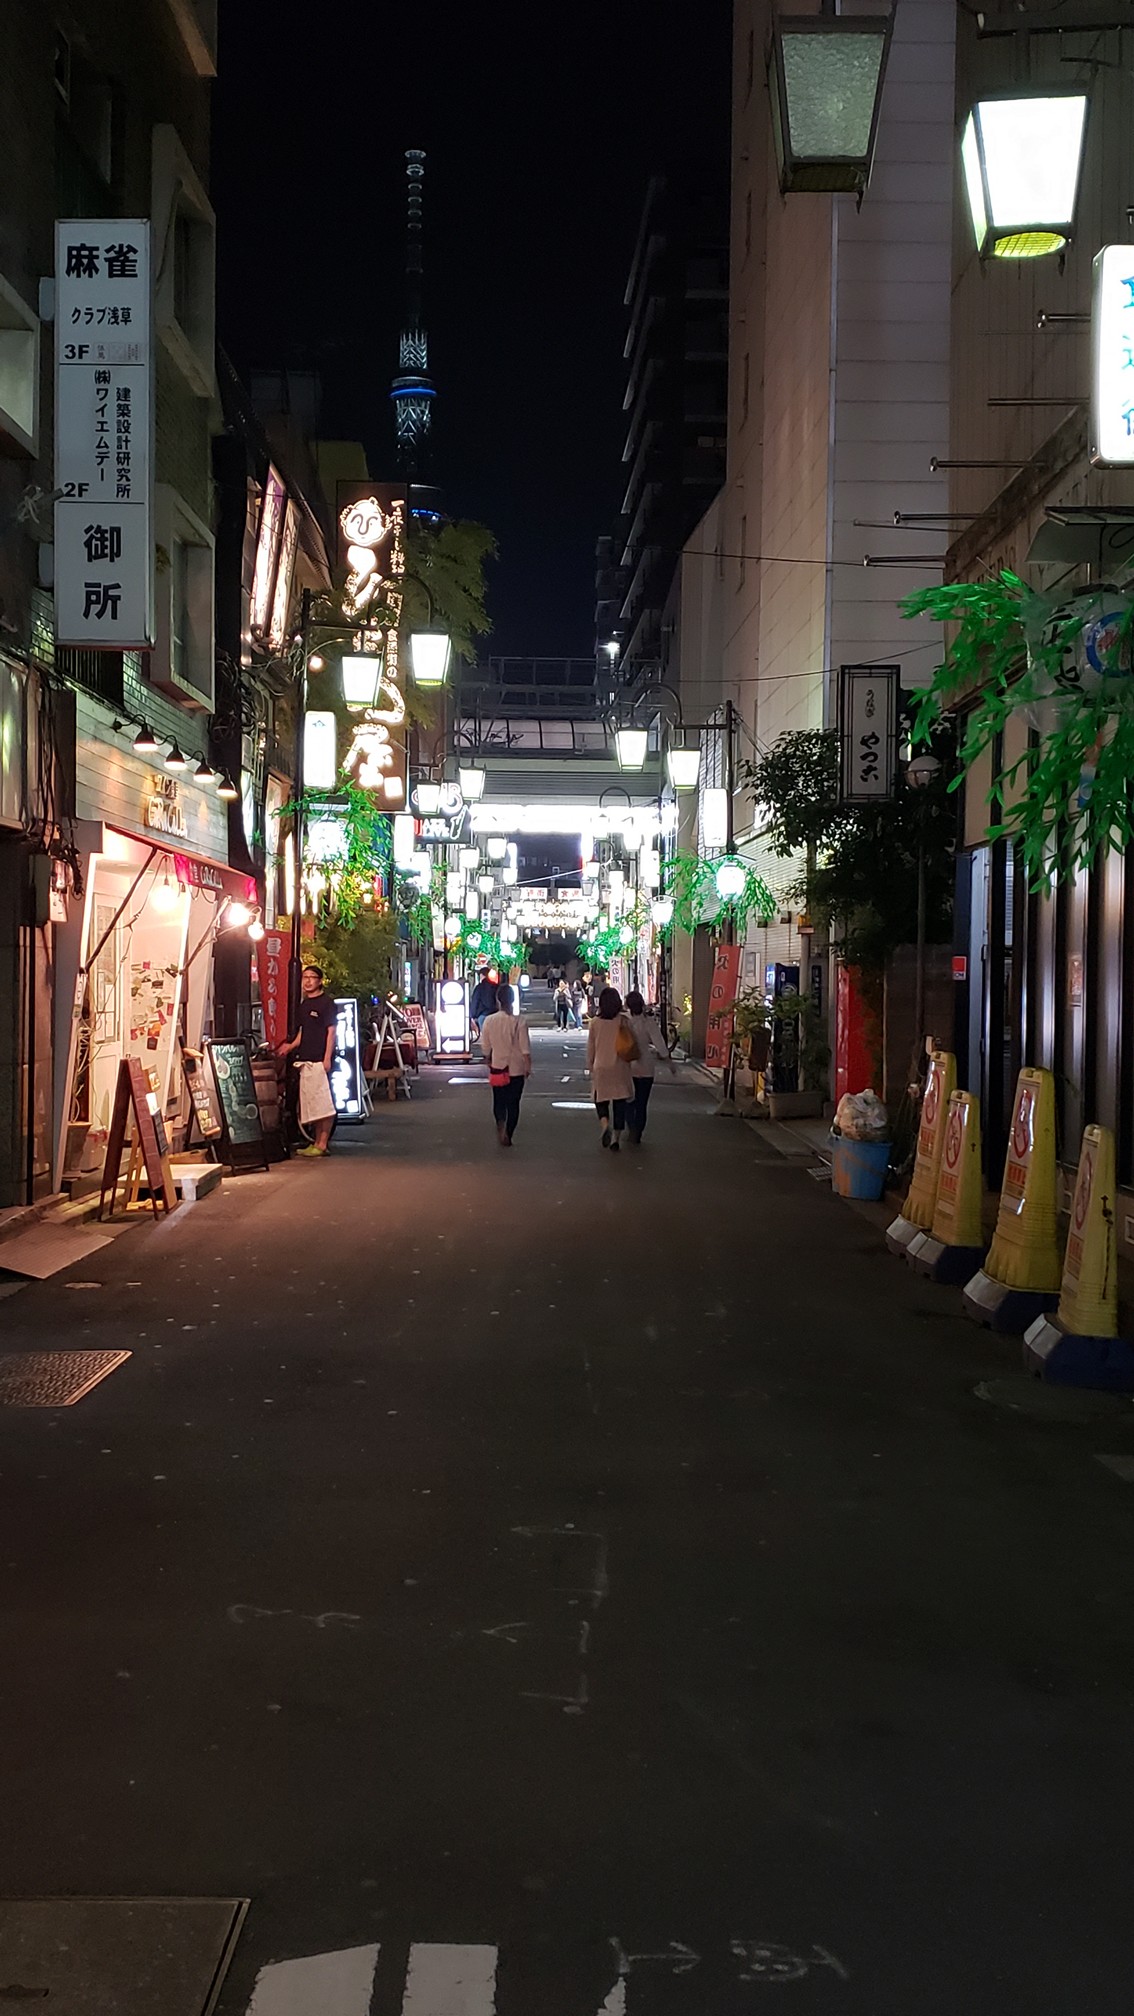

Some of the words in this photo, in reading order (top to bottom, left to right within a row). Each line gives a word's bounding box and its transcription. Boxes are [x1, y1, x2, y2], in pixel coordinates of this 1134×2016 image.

[66, 243, 138, 279] 麻雀
[71, 306, 132, 326] クラブ浅草
[64, 344, 90, 360] 3F
[116, 387, 132, 499] 建築設計研究所
[64, 482, 90, 498] 2F
[83, 524, 122, 621] 御所
